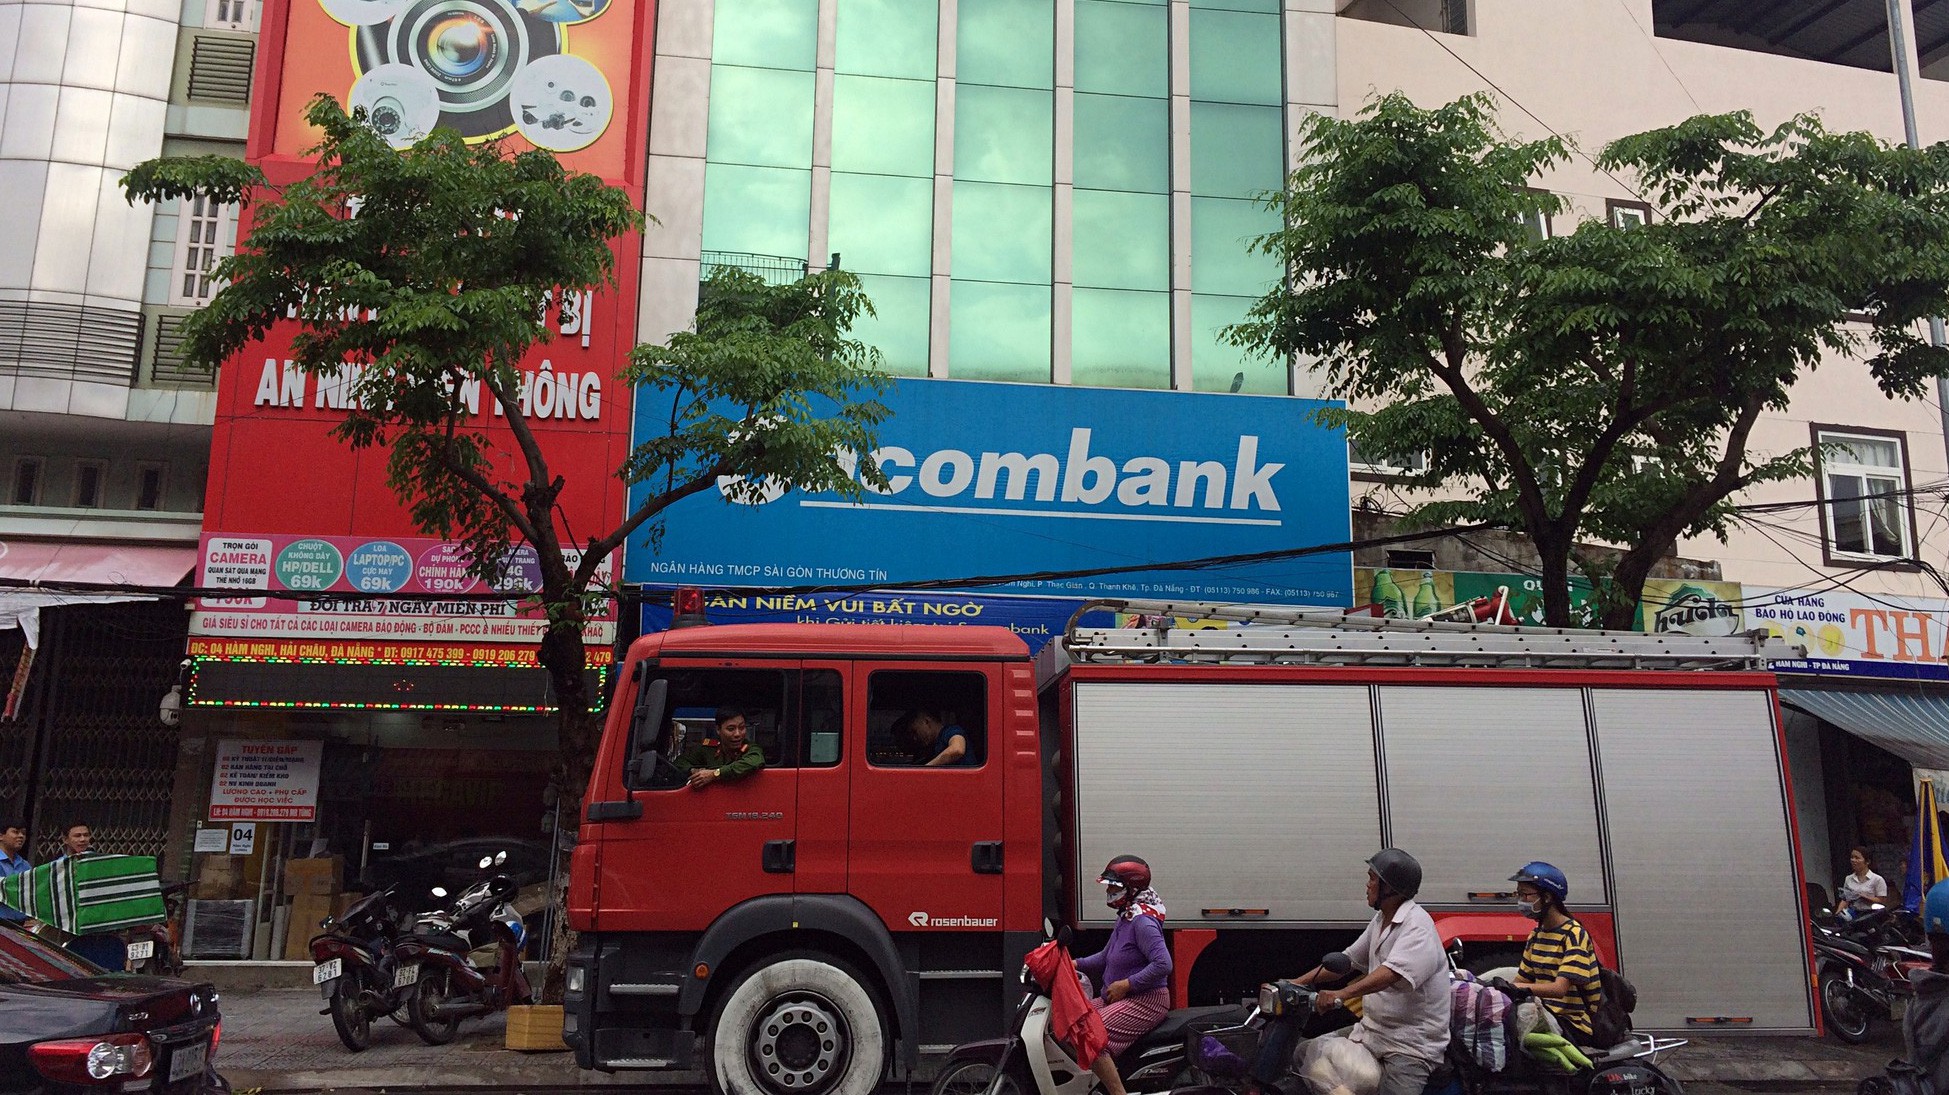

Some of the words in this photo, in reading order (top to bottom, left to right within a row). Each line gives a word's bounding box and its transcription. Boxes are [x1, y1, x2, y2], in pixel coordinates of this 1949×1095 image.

[254, 358, 307, 408] AN
[223, 542, 243, 552] TRỌN
[245, 541, 258, 550] GÓI
[298, 542, 323, 551] CHUỘT
[373, 544, 387, 553] LOA
[210, 552, 267, 565] CAMERA
[288, 550, 314, 560] KHÔNG
[316, 551, 331, 560] DÂY
[353, 553, 405, 566] LAPTOP/PC
[208, 566, 224, 574] QUAN
[237, 567, 249, 575] QUA
[250, 567, 267, 577] MẠNG
[282, 561, 334, 574] HP/DELL
[378, 568, 393, 576] HAY
[419, 563, 448, 578] CHÍNH
[650, 560, 686, 574] NGÂN
[689, 562, 724, 575] HÀNG
[727, 564, 760, 577] TMCP
[764, 563, 783, 577] SÀI
[786, 564, 813, 579] GÒN
[817, 566, 865, 581] THƯƠNG
[869, 567, 888, 582] TÍN
[290, 574, 322, 588] 69k
[360, 576, 391, 590] 69k
[424, 578, 464, 590] 190k
[1099, 582, 1121, 591] Thanh
[1204, 586, 1231, 595] (05113)
[1233, 587, 1246, 595] 750
[377, 601, 386, 613] 7
[755, 593, 817, 613] NIỀM
[823, 599, 864, 613] VUI
[872, 597, 917, 615] BẤT
[922, 601, 984, 618] NGỜ
[1797, 611, 1815, 622] LAO
[202, 614, 217, 629] GIÁ
[250, 618, 268, 630] CHO
[300, 617, 317, 631] CÁC
[319, 619, 338, 635] LOẠI
[340, 621, 373, 633] CAMERA
[460, 623, 481, 635] PCCC
[1849, 608, 1949, 663] TH
[191, 642, 208, 654] ĐC:
[210, 642, 223, 655] 04
[225, 640, 249, 656] HÀM
[250, 643, 278, 657] NGHI,
[280, 640, 297, 656] HẢI
[331, 642, 345, 657] ĐÀ
[384, 646, 399, 658] ĐT:
[400, 647, 425, 659] 0917
[426, 647, 444, 660] 475
[446, 648, 464, 660] 399
[472, 648, 496, 660] 0919
[498, 649, 516, 661] 206
[518, 650, 536, 662] 279
[594, 651, 612, 663] 479
[234, 828, 253, 841] 04
[931, 915, 998, 927] rosenbauer
